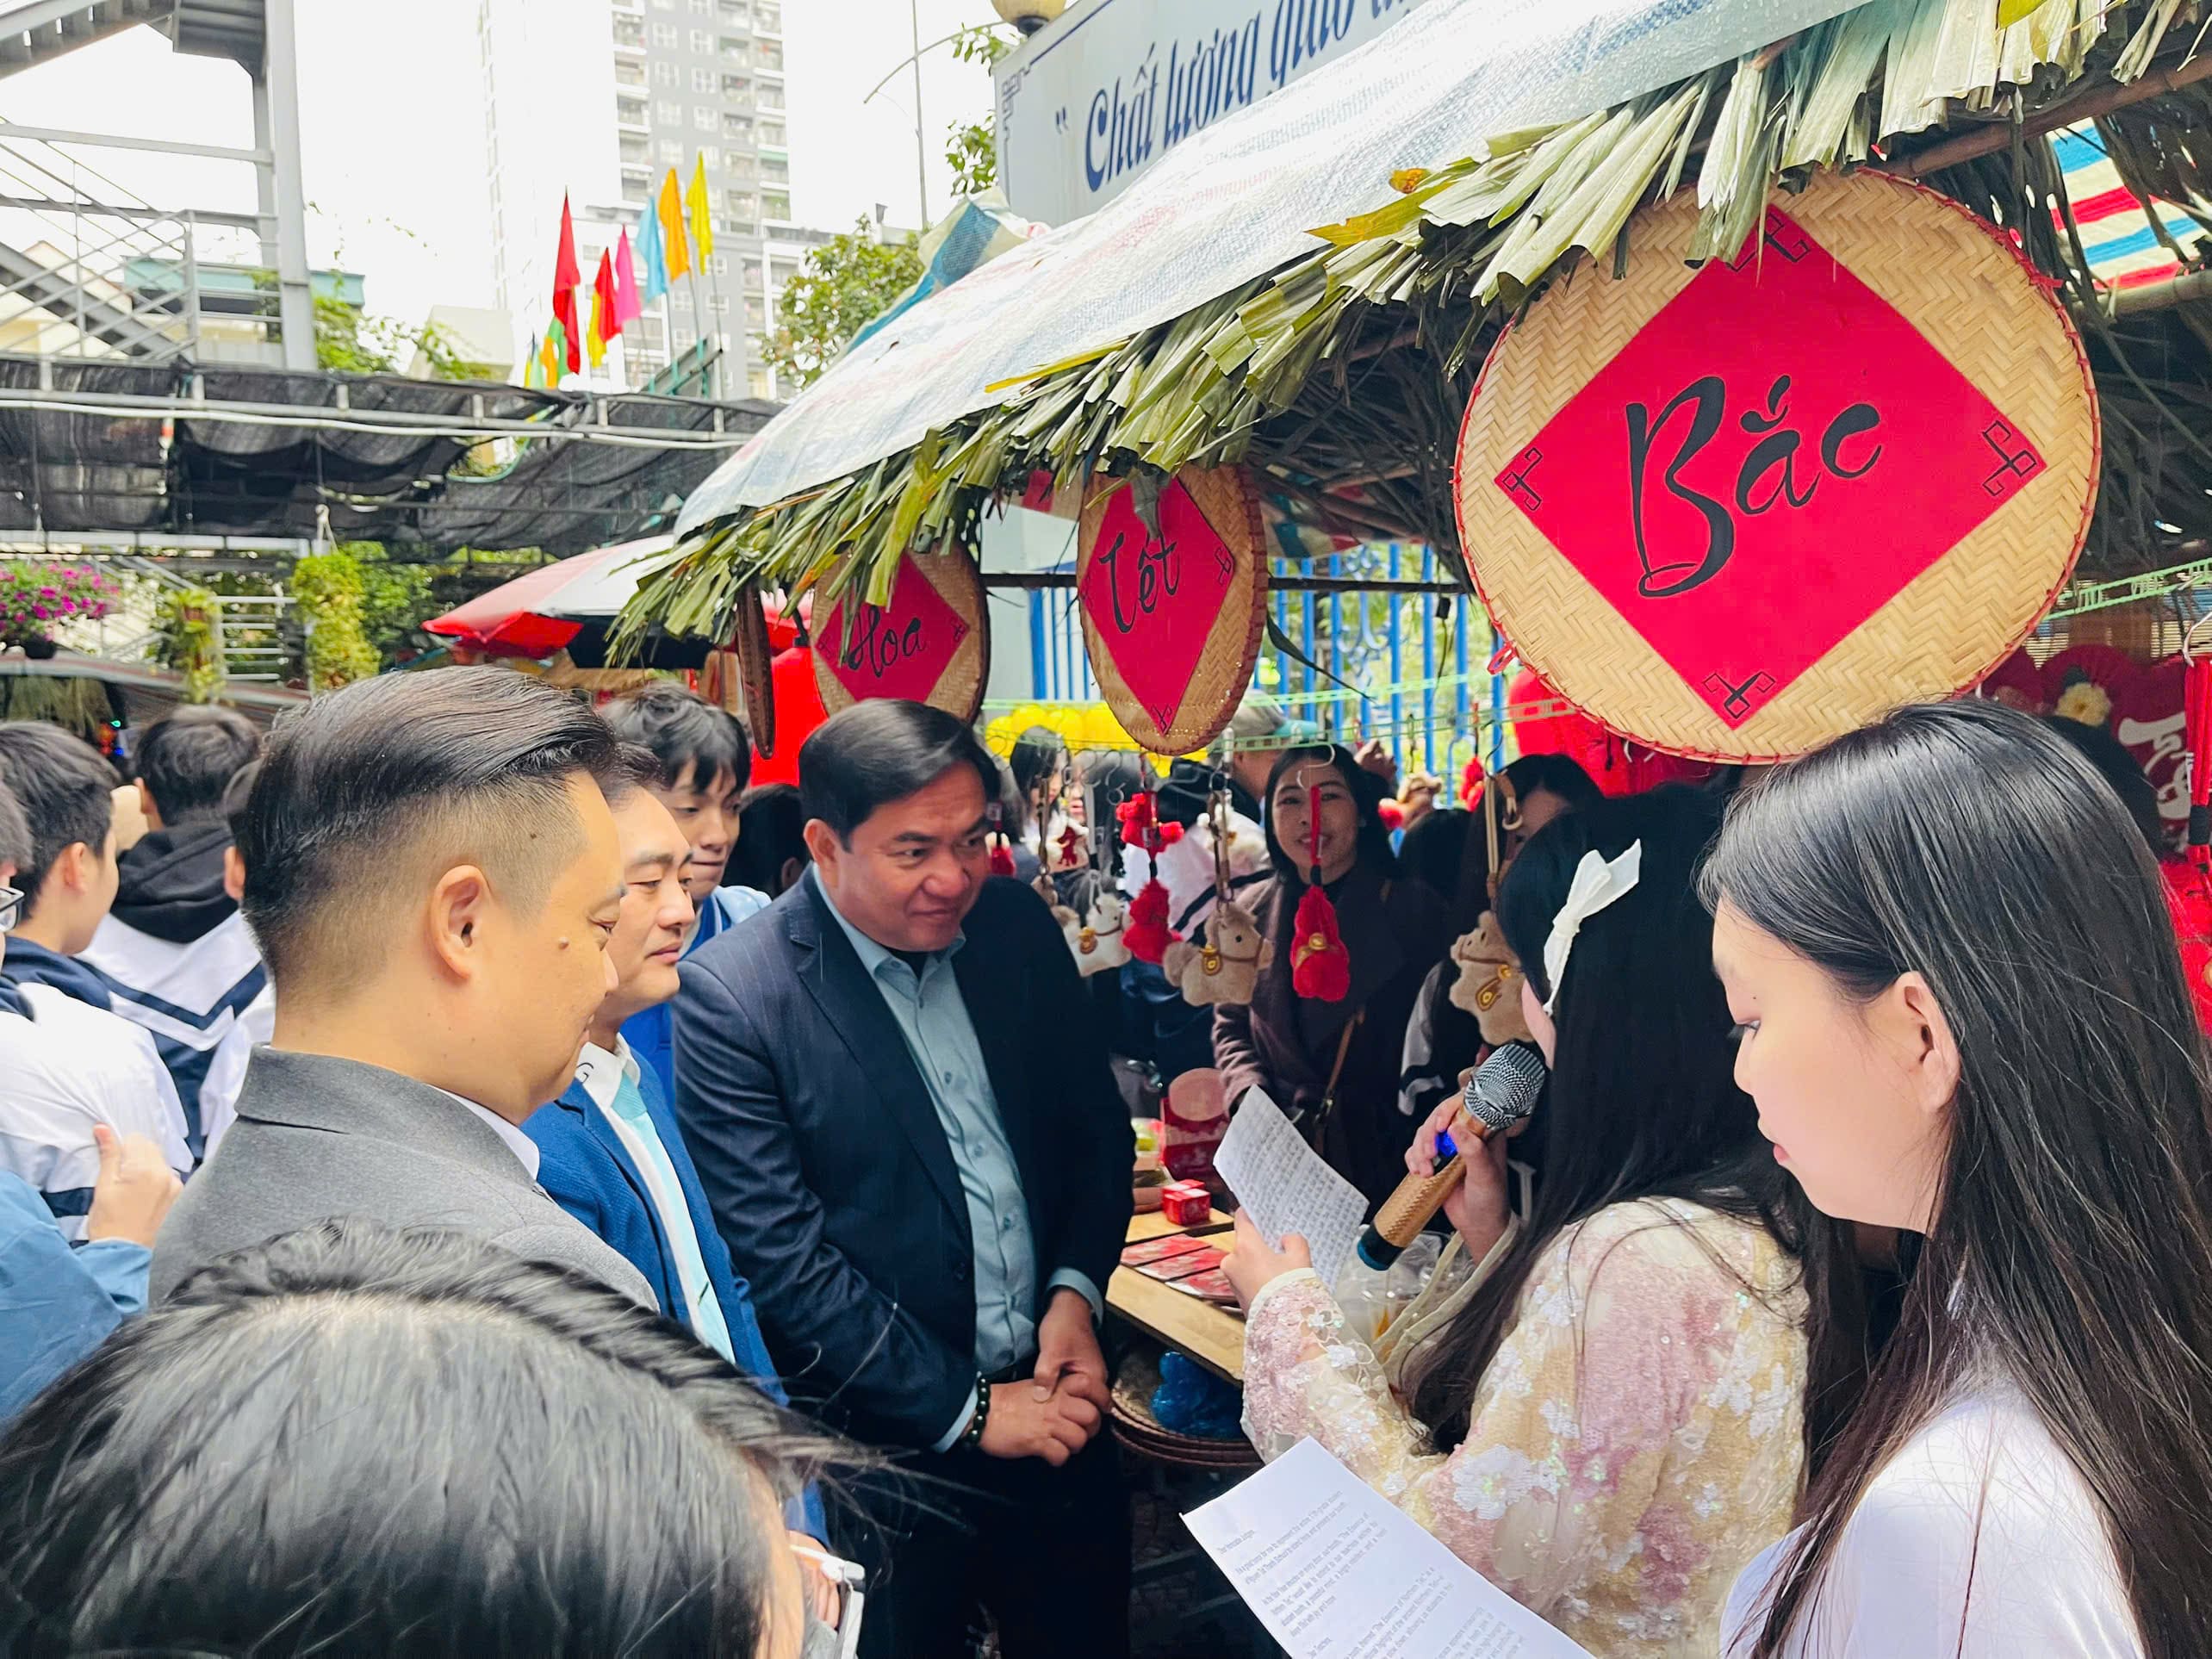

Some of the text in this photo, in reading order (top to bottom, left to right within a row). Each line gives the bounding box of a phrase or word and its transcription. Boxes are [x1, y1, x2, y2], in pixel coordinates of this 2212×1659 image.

[1085, 41, 1159, 193] Chất
[1625, 375, 1882, 598] Bắc
[847, 604, 928, 679] Hoa
